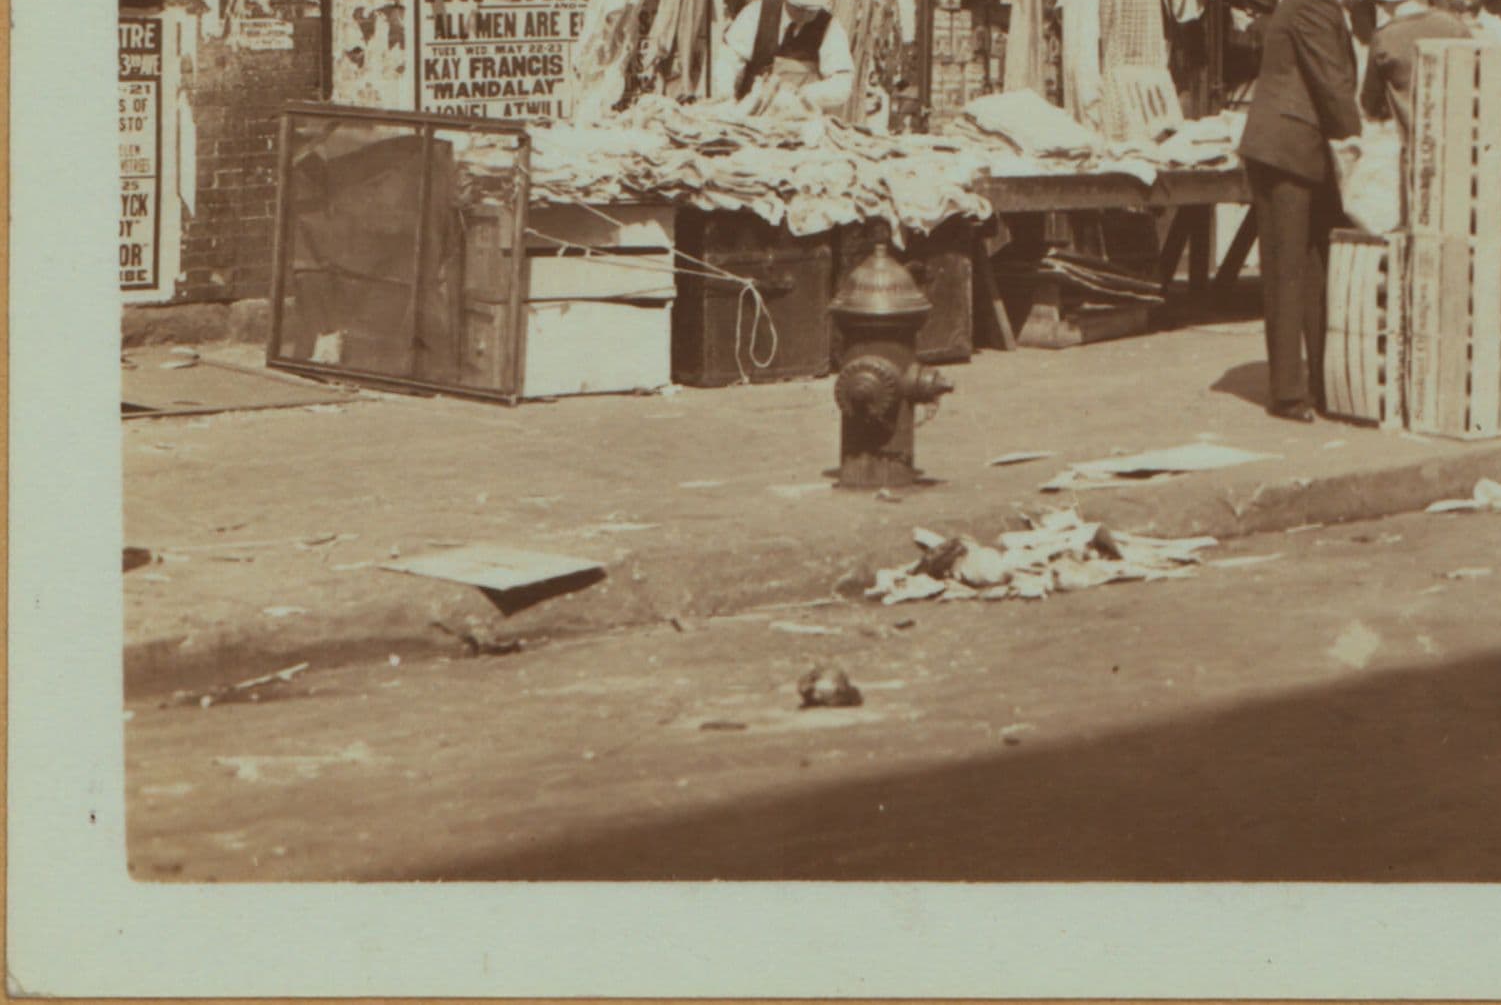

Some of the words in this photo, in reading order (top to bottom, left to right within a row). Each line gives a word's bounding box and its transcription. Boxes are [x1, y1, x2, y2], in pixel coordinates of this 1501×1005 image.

[475, 12, 516, 39] MEN
[524, 11, 560, 38] ARE
[495, 46, 523, 54] MAY
[425, 58, 461, 81] KAY
[469, 54, 564, 79] FRANCIS
[133, 98, 149, 114] OF
